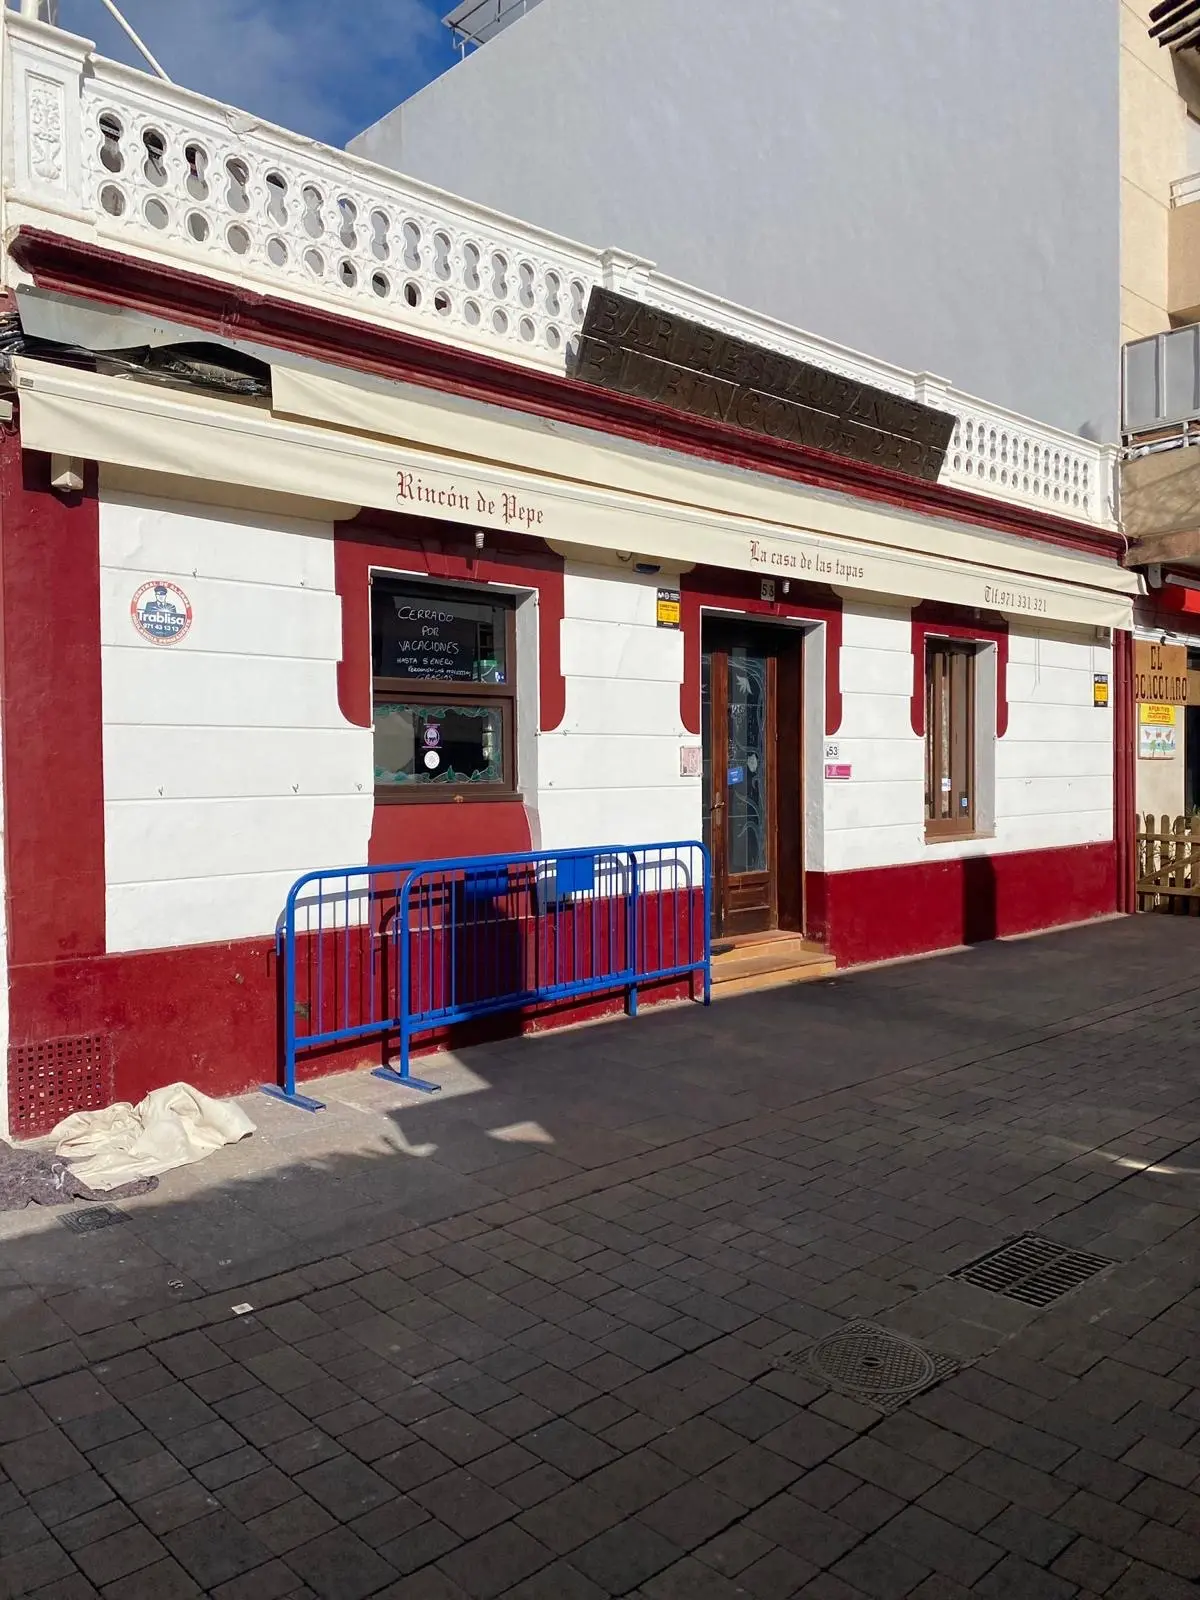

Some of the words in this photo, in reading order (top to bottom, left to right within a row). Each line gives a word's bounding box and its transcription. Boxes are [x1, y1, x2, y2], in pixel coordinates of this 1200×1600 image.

[589, 293, 679, 358] BAR
[396, 471, 470, 511] Rincón
[477, 491, 496, 515] de
[502, 492, 544, 529] Pepe
[750, 540, 767, 567] La
[771, 552, 797, 568] casa
[800, 552, 812, 570] de
[816, 554, 832, 573] las
[836, 559, 864, 581] tapas
[762, 584, 774, 597] 53
[1017, 594, 1032, 610] 331
[1034, 598, 1047, 613] 321
[138, 610, 185, 626] Trablisa
[397, 606, 454, 622] CERRADO
[422, 625, 440, 636] POR
[398, 640, 460, 655] VACACIONES
[430, 657, 454, 666] ENERO
[1151, 645, 1163, 671] EL
[828, 746, 838, 756] 53
